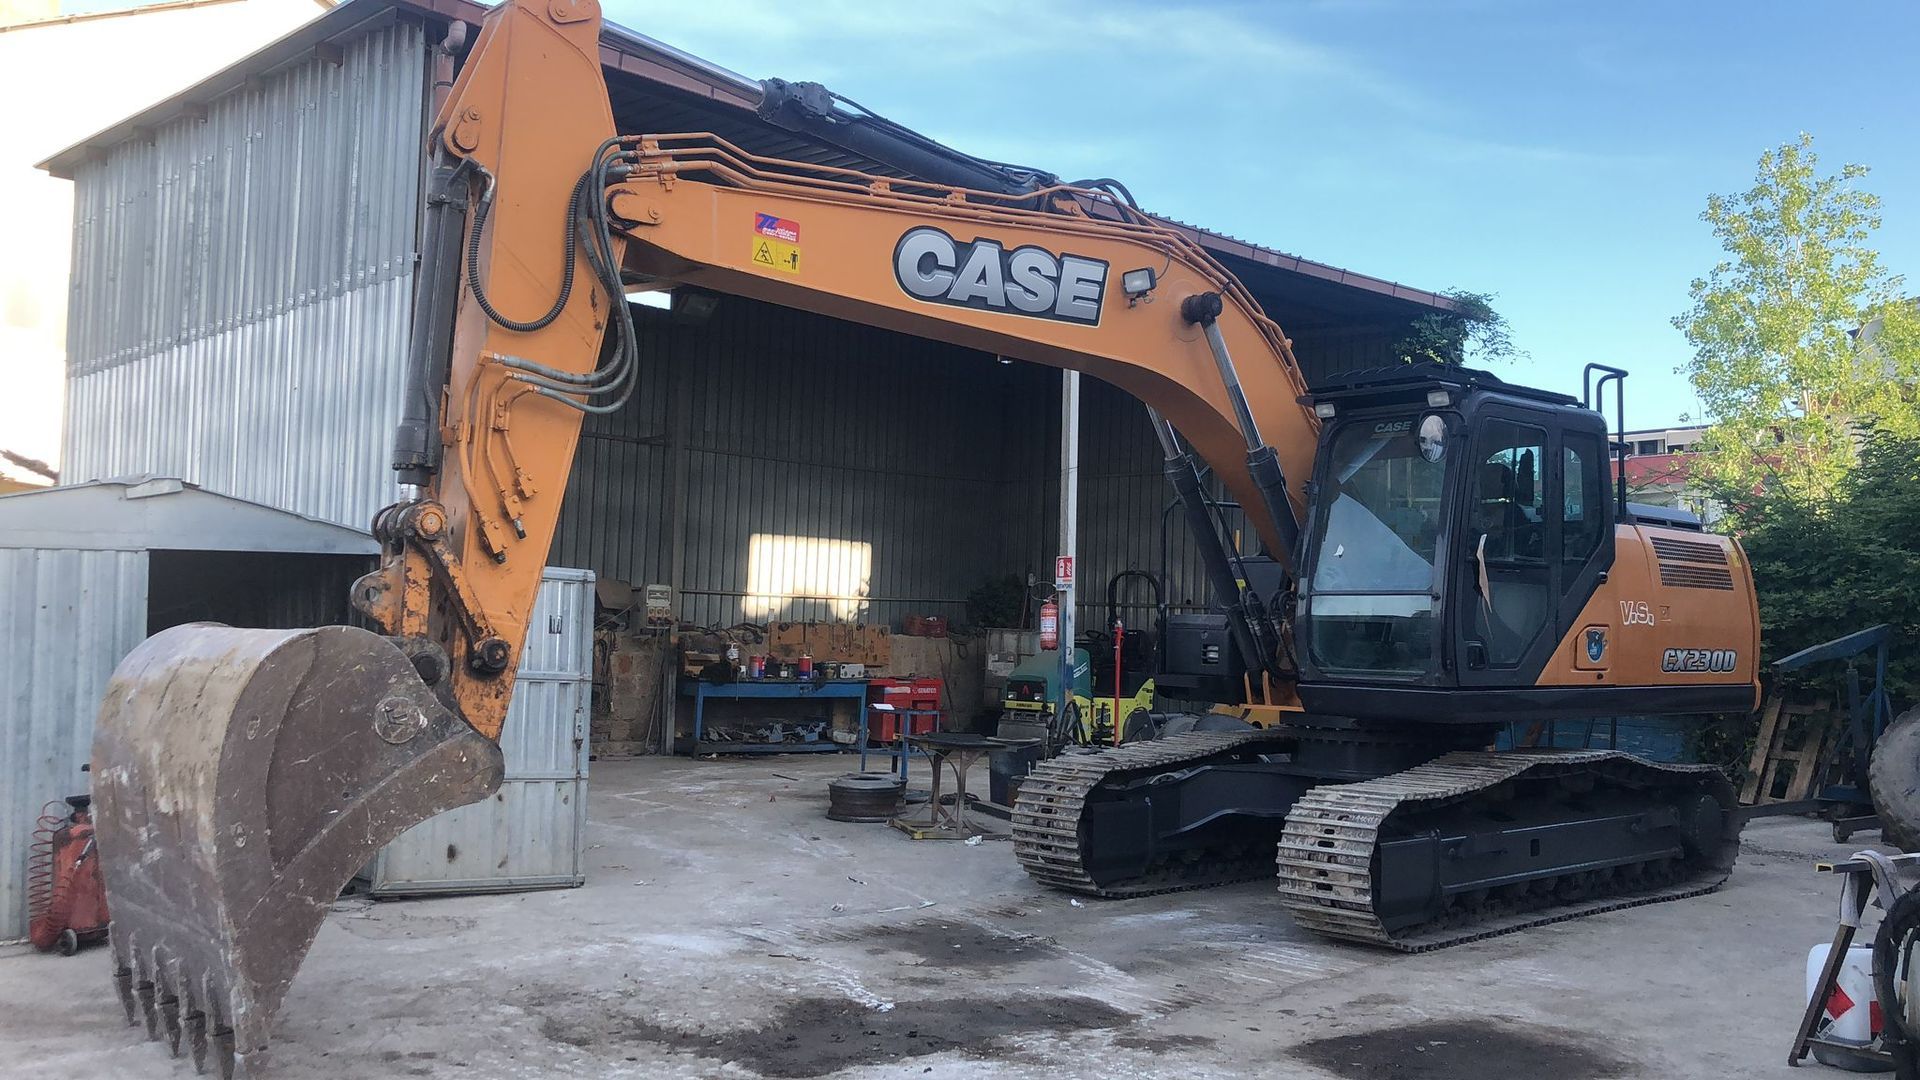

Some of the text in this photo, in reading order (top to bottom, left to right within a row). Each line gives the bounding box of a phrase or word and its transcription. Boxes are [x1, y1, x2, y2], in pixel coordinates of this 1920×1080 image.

[895, 227, 1107, 322] CASE
[1374, 420, 1412, 433] CASE
[1661, 648, 1737, 673] CX230D
